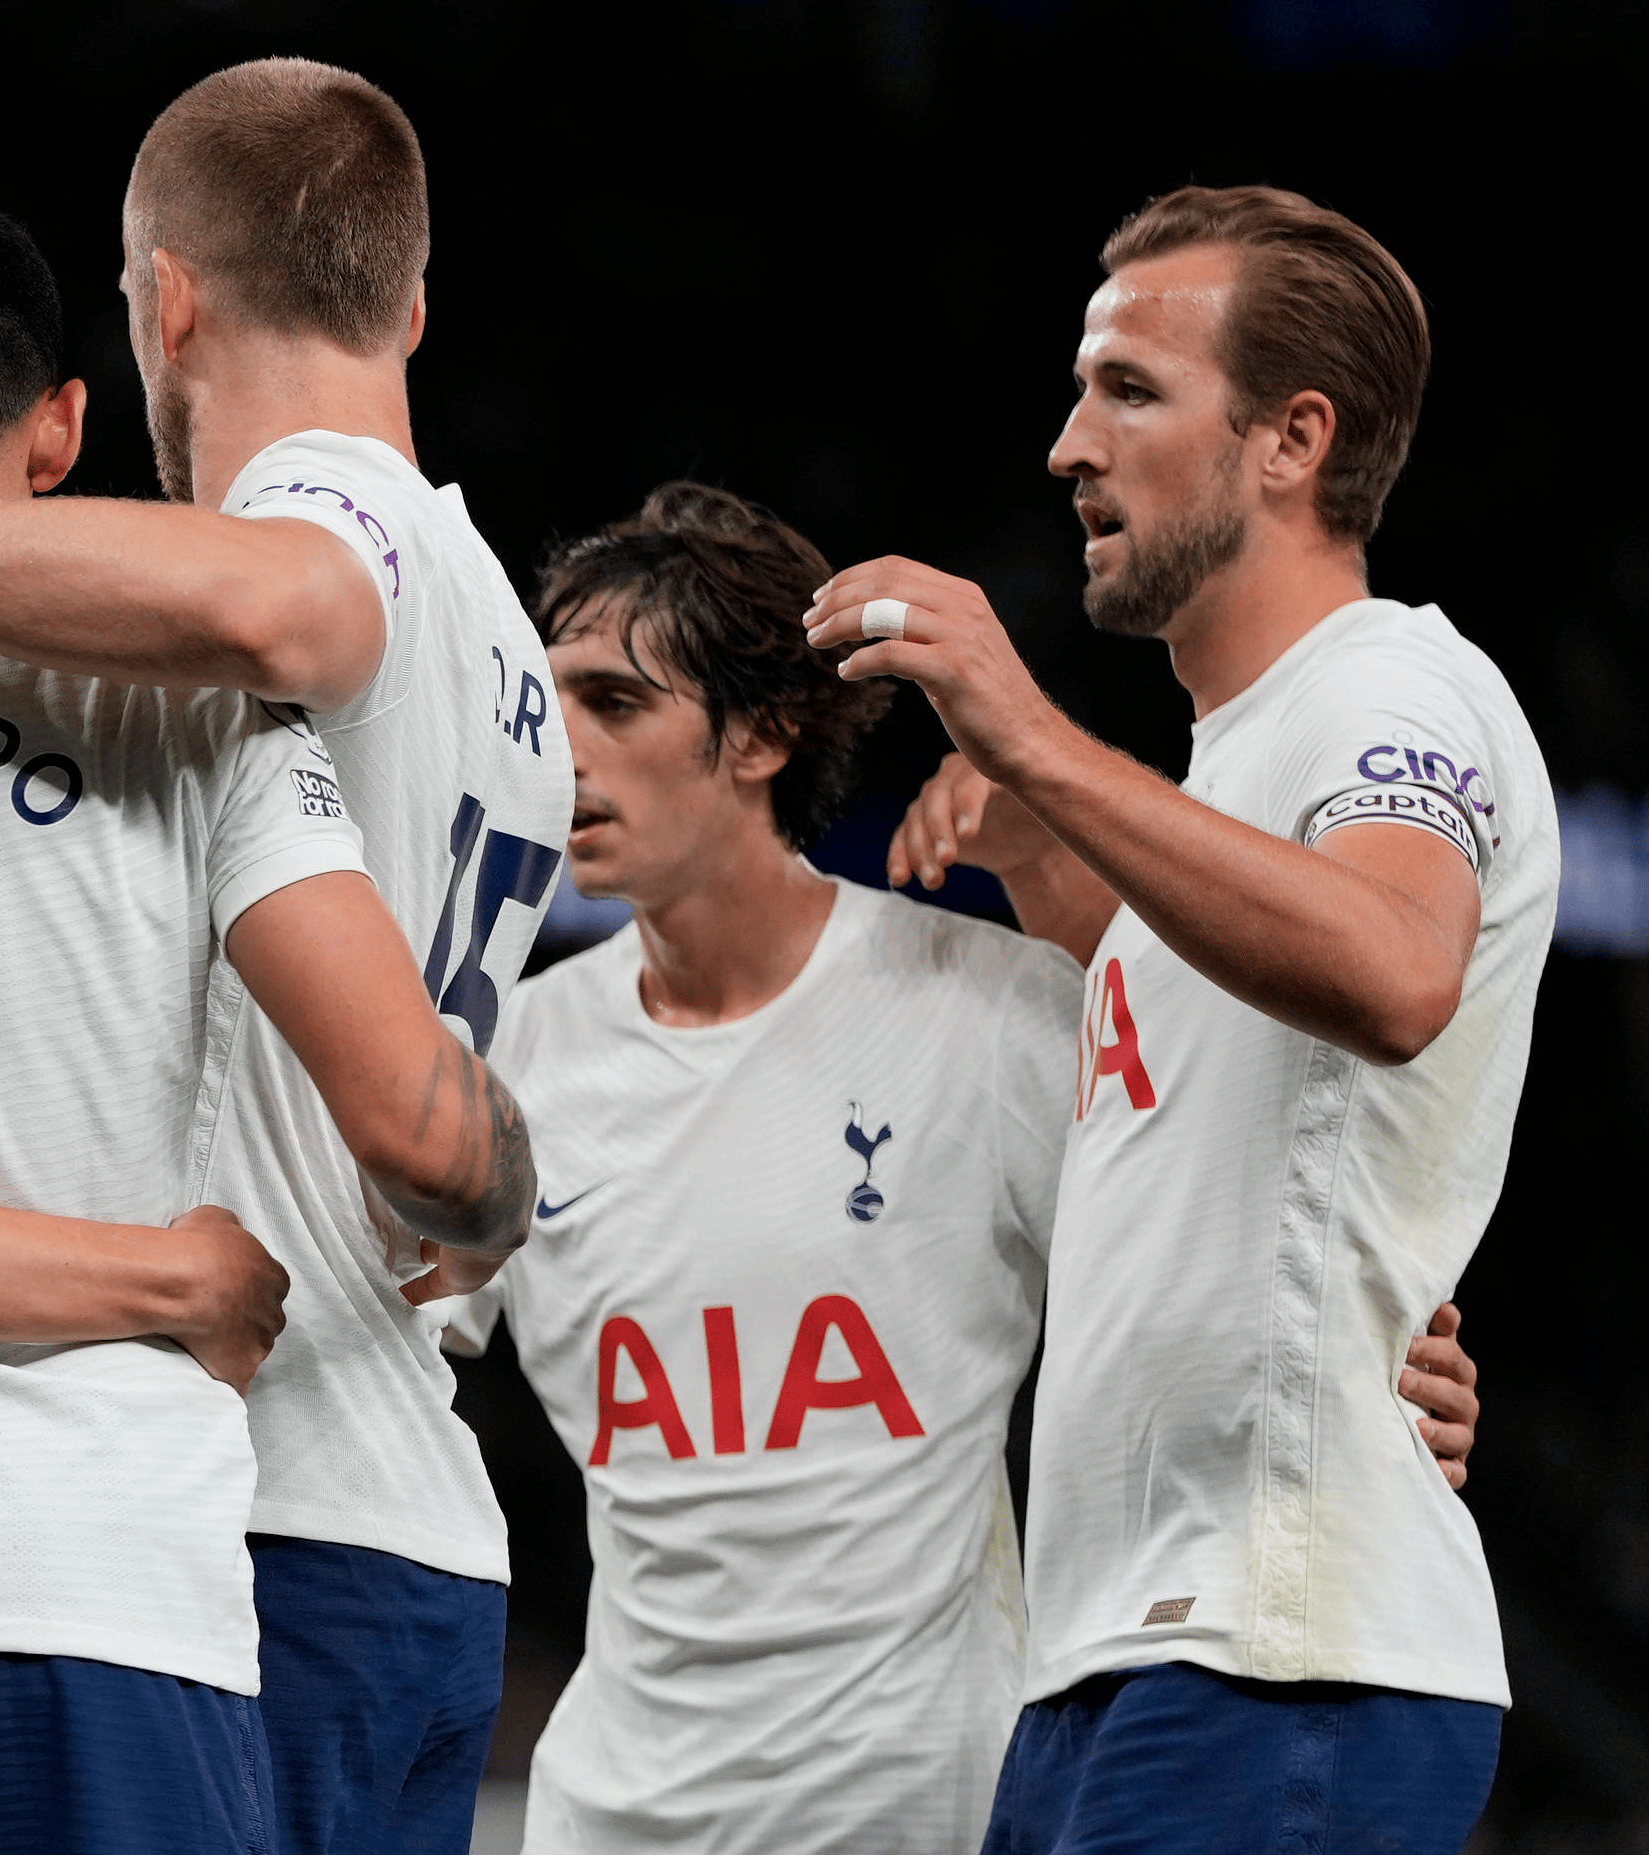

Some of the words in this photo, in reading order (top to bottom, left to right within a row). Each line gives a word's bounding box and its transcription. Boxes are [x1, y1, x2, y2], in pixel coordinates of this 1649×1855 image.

[291, 770, 321, 796] No
[424, 792, 561, 1060] 15
[587, 1294, 927, 1468] AIA
